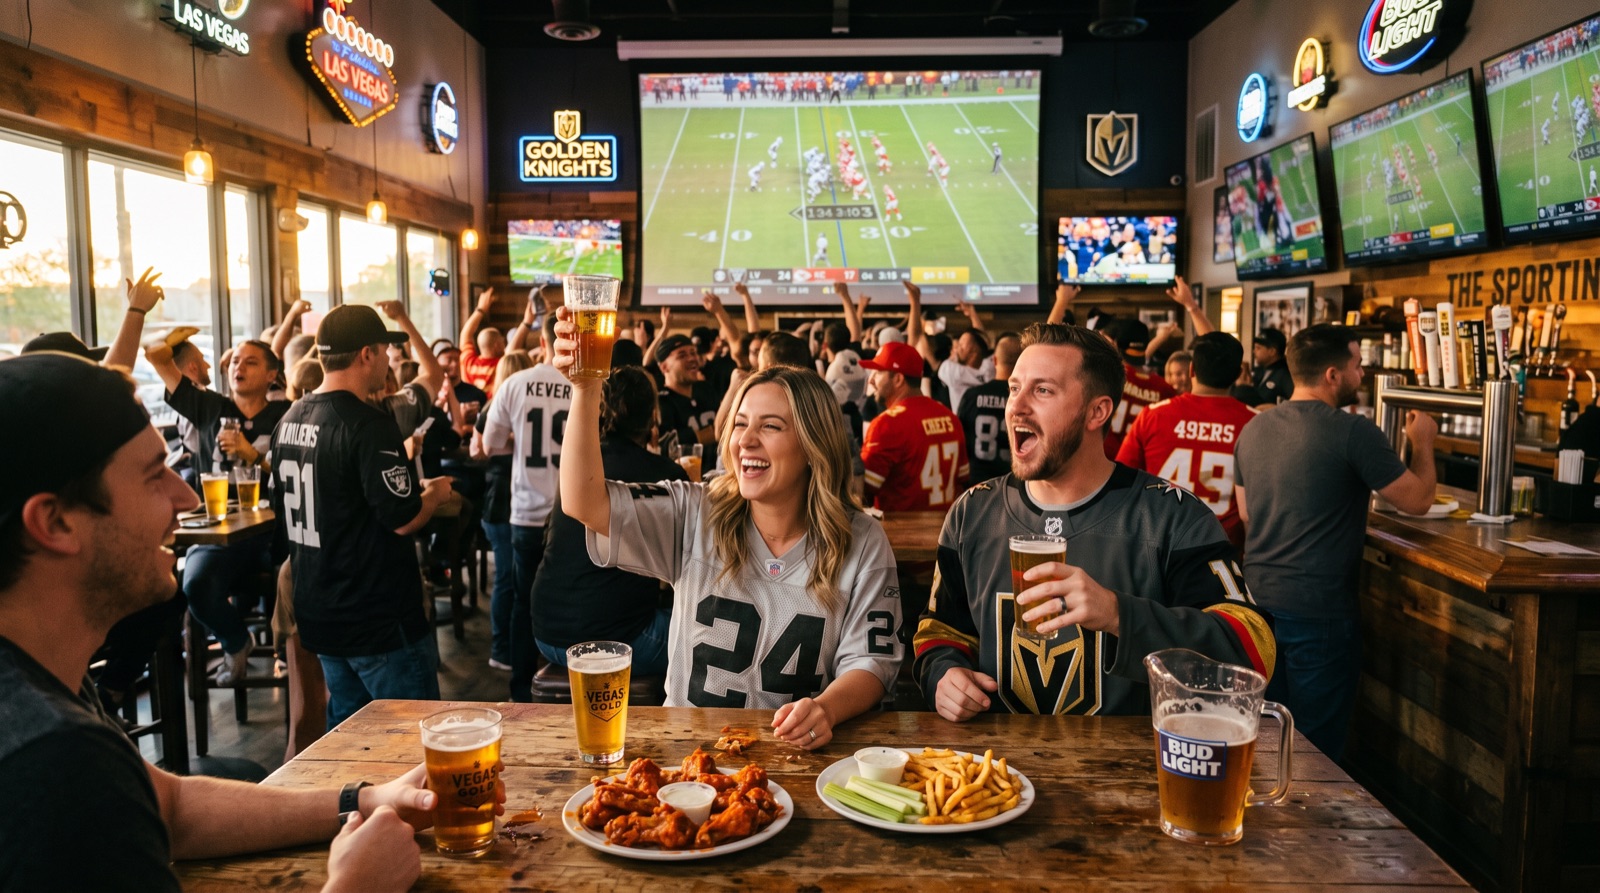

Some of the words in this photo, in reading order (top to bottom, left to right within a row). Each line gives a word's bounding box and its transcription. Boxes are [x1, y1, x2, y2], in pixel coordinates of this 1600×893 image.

[174, 0, 203, 31] LAS
[205, 13, 249, 55] VEGAS
[1368, 0, 1443, 61] LIGHT
[324, 50, 349, 83] LAS
[350, 65, 389, 104] VEGAS
[526, 141, 610, 159] GOLDEN
[524, 159, 612, 177] KNIGHTS
[777, 270, 791, 281] 24
[1447, 270, 1484, 308] THE
[1173, 420, 1235, 443] 49ERS
[921, 441, 959, 506] 47
[279, 459, 321, 548] 21
[687, 594, 826, 709] 24
[586, 688, 624, 703] VEGAS
[591, 701, 622, 711] GOLD
[1168, 738, 1213, 760] BUD
[1163, 750, 1222, 777] LIGHT
[452, 765, 496, 788] VEGAS
[458, 781, 494, 797] GOLD
